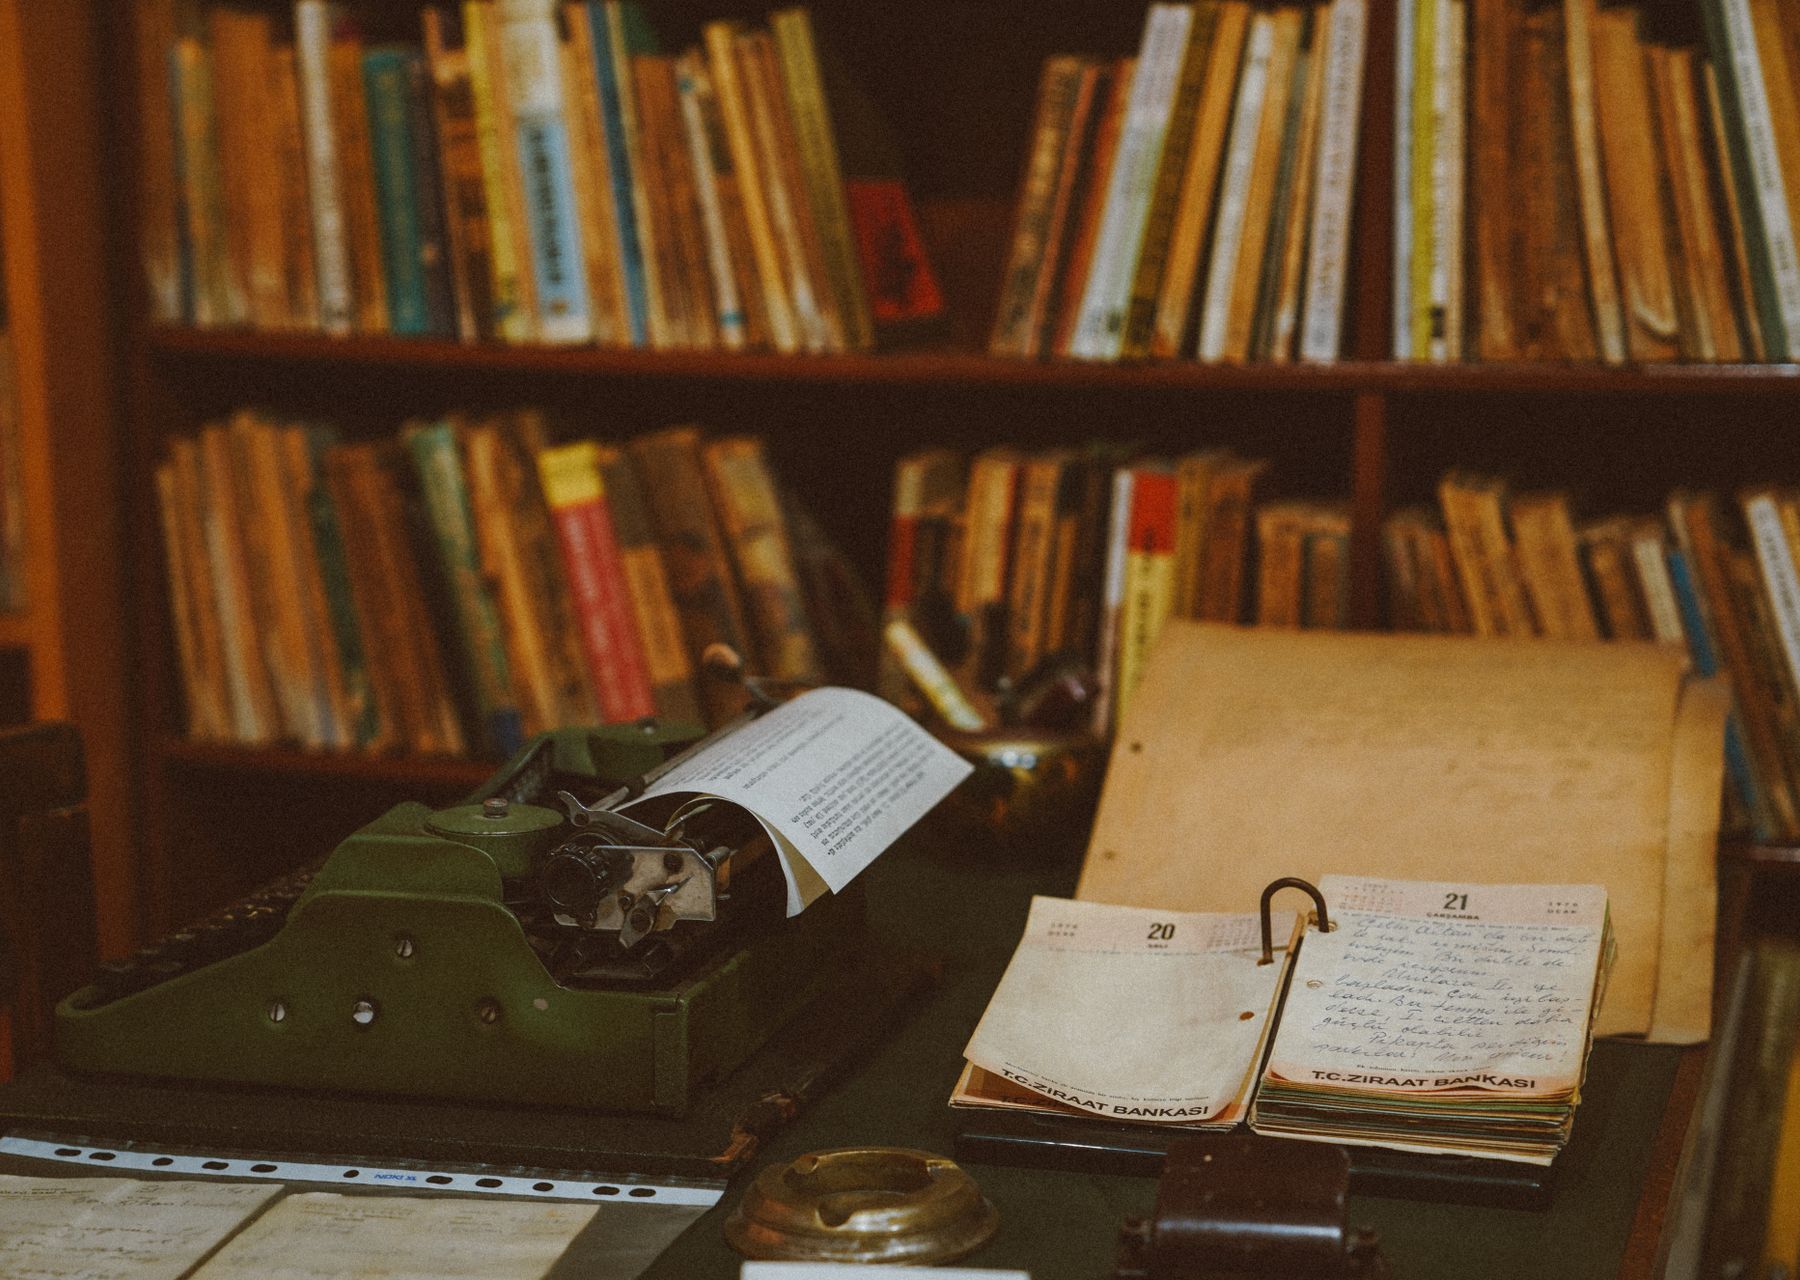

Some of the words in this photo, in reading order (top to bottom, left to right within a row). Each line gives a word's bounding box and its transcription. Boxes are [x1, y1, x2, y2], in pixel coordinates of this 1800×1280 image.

[1443, 892, 1468, 911] 21
[1147, 923, 1175, 941] 20
[1434, 1070, 1536, 1089] BANKASI
[1113, 1105, 1208, 1117] BANKASI
